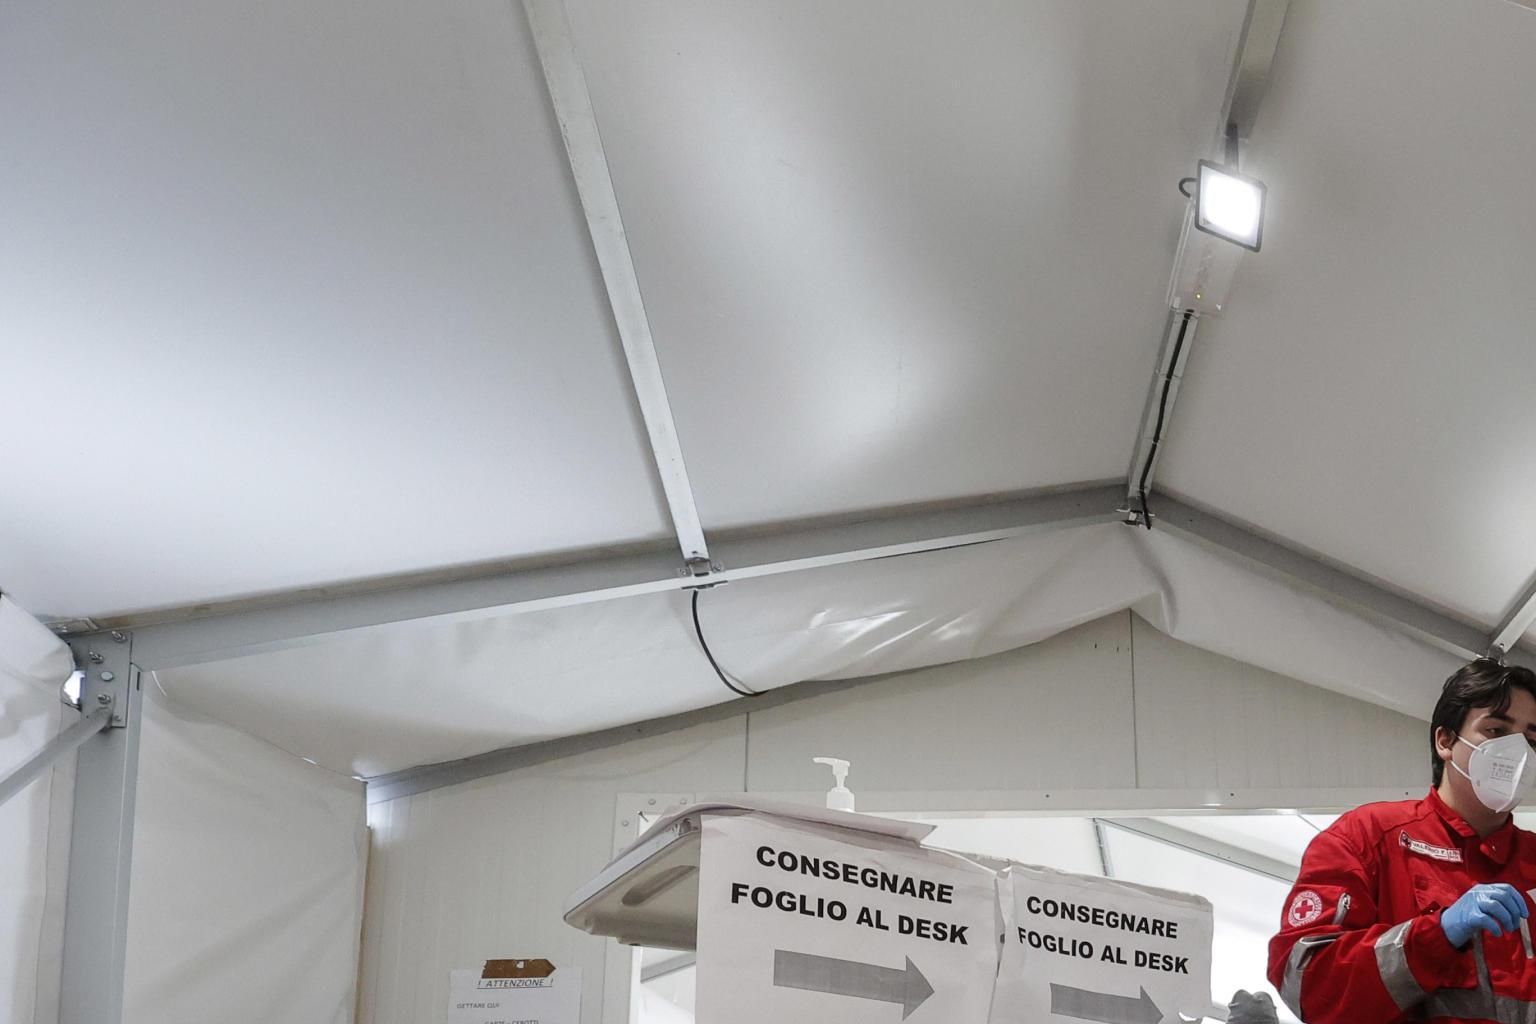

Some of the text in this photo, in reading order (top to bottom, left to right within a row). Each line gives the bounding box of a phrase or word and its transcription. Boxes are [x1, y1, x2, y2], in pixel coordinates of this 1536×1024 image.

[756, 845, 954, 904] CONSEGNARE
[730, 882, 969, 946] FOGLIO AL DESK
[1026, 895, 1179, 940] CONSEGNARE
[1016, 925, 1190, 975] FOGLIO AL DESK
[485, 978, 545, 988] ATTENZIONE
